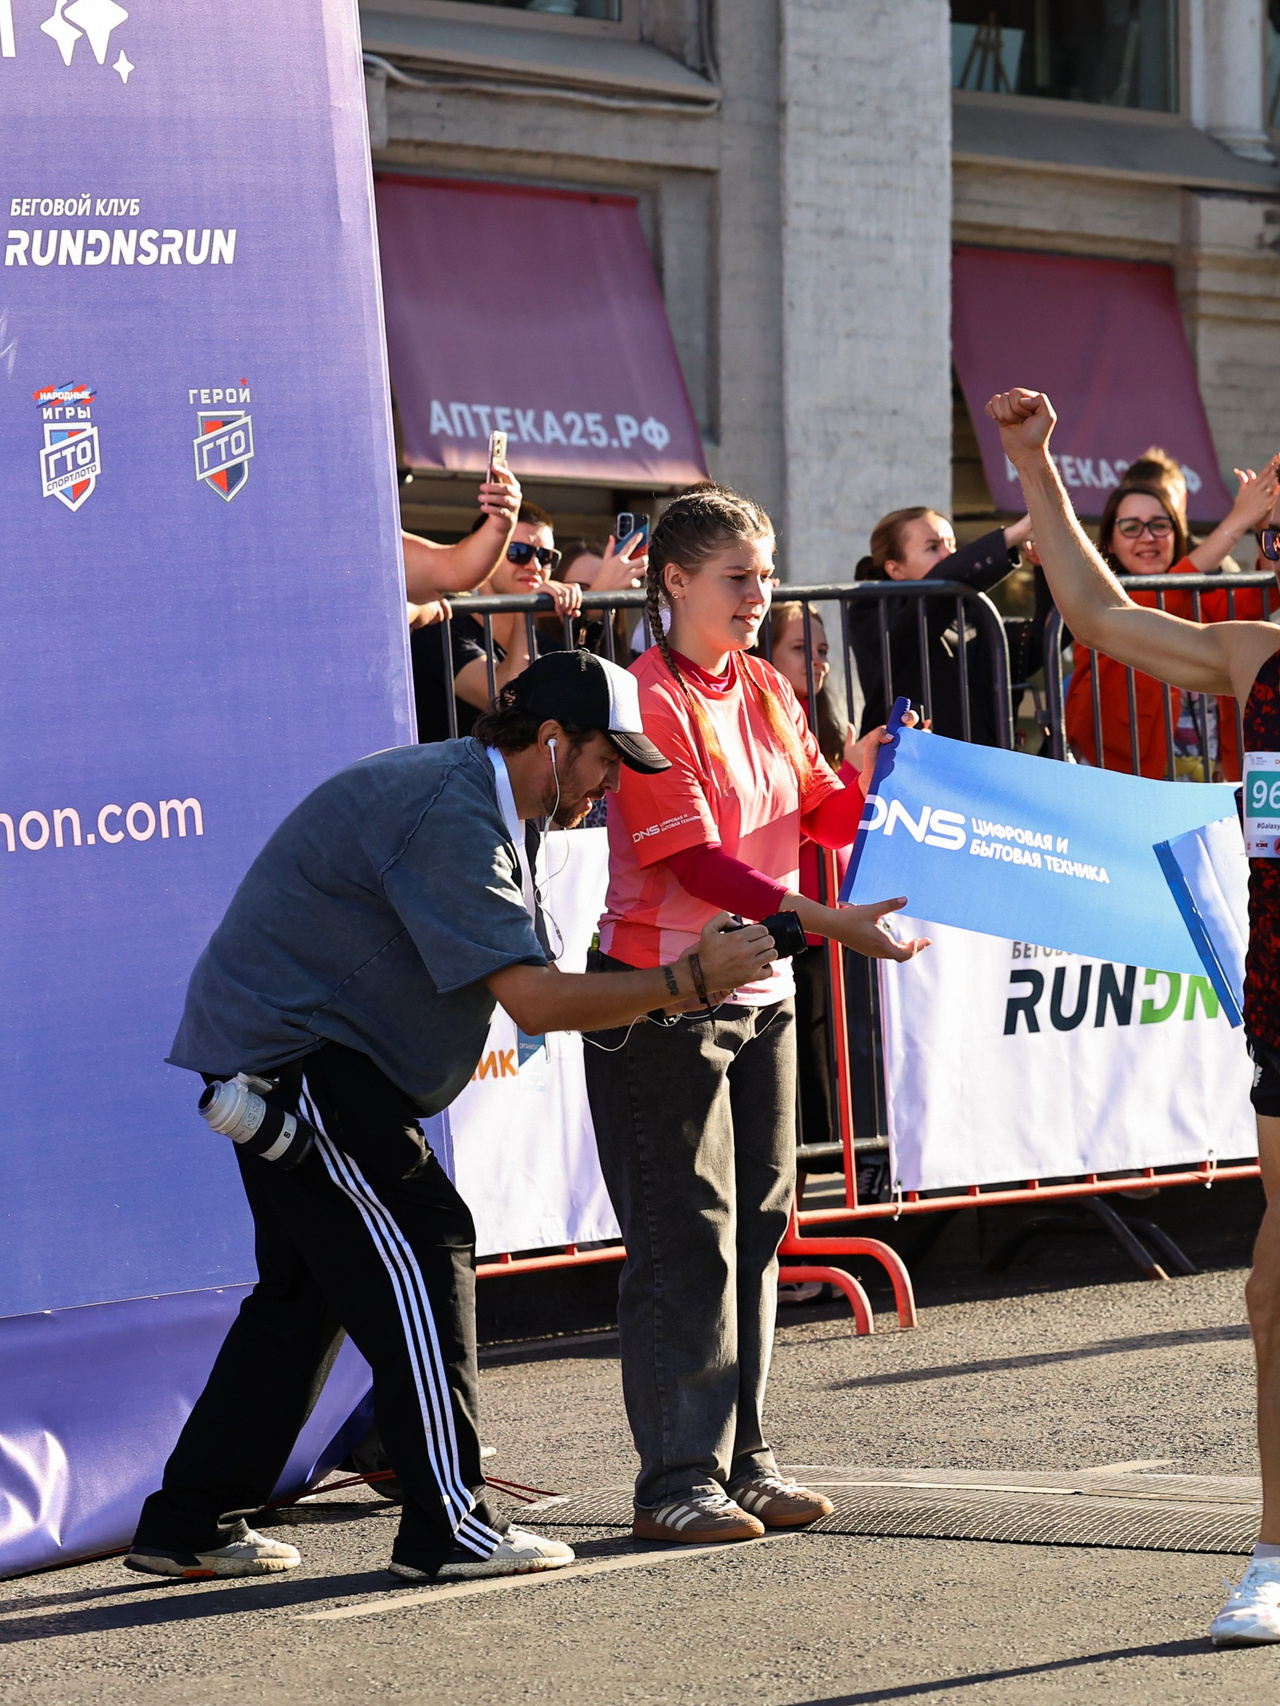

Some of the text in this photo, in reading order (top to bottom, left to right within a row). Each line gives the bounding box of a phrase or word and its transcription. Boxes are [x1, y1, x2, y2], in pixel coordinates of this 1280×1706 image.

[10, 193, 141, 217] БЕГОВОЙ КЛУБ
[4, 228, 237, 267] RUNDNSRUN
[39, 391, 91, 401] НАРОДНЫЕ
[42, 406, 92, 420] ИГРЫ
[429, 399, 671, 451] АПТЕКА25.РФ
[48, 439, 92, 479] ГТО
[202, 429, 247, 470] ГТО
[46, 464, 97, 492] СПОРТЛОТО
[632, 824, 660, 843] DNS
[857, 794, 967, 851] DNS
[971, 817, 1069, 854] ЦИФРОВАЯ И
[969, 838, 1110, 884] БЫТОВАЯ ТЕХНИКА
[1003, 963, 1219, 1036] RUNDN
[471, 1048, 519, 1081] ИК
